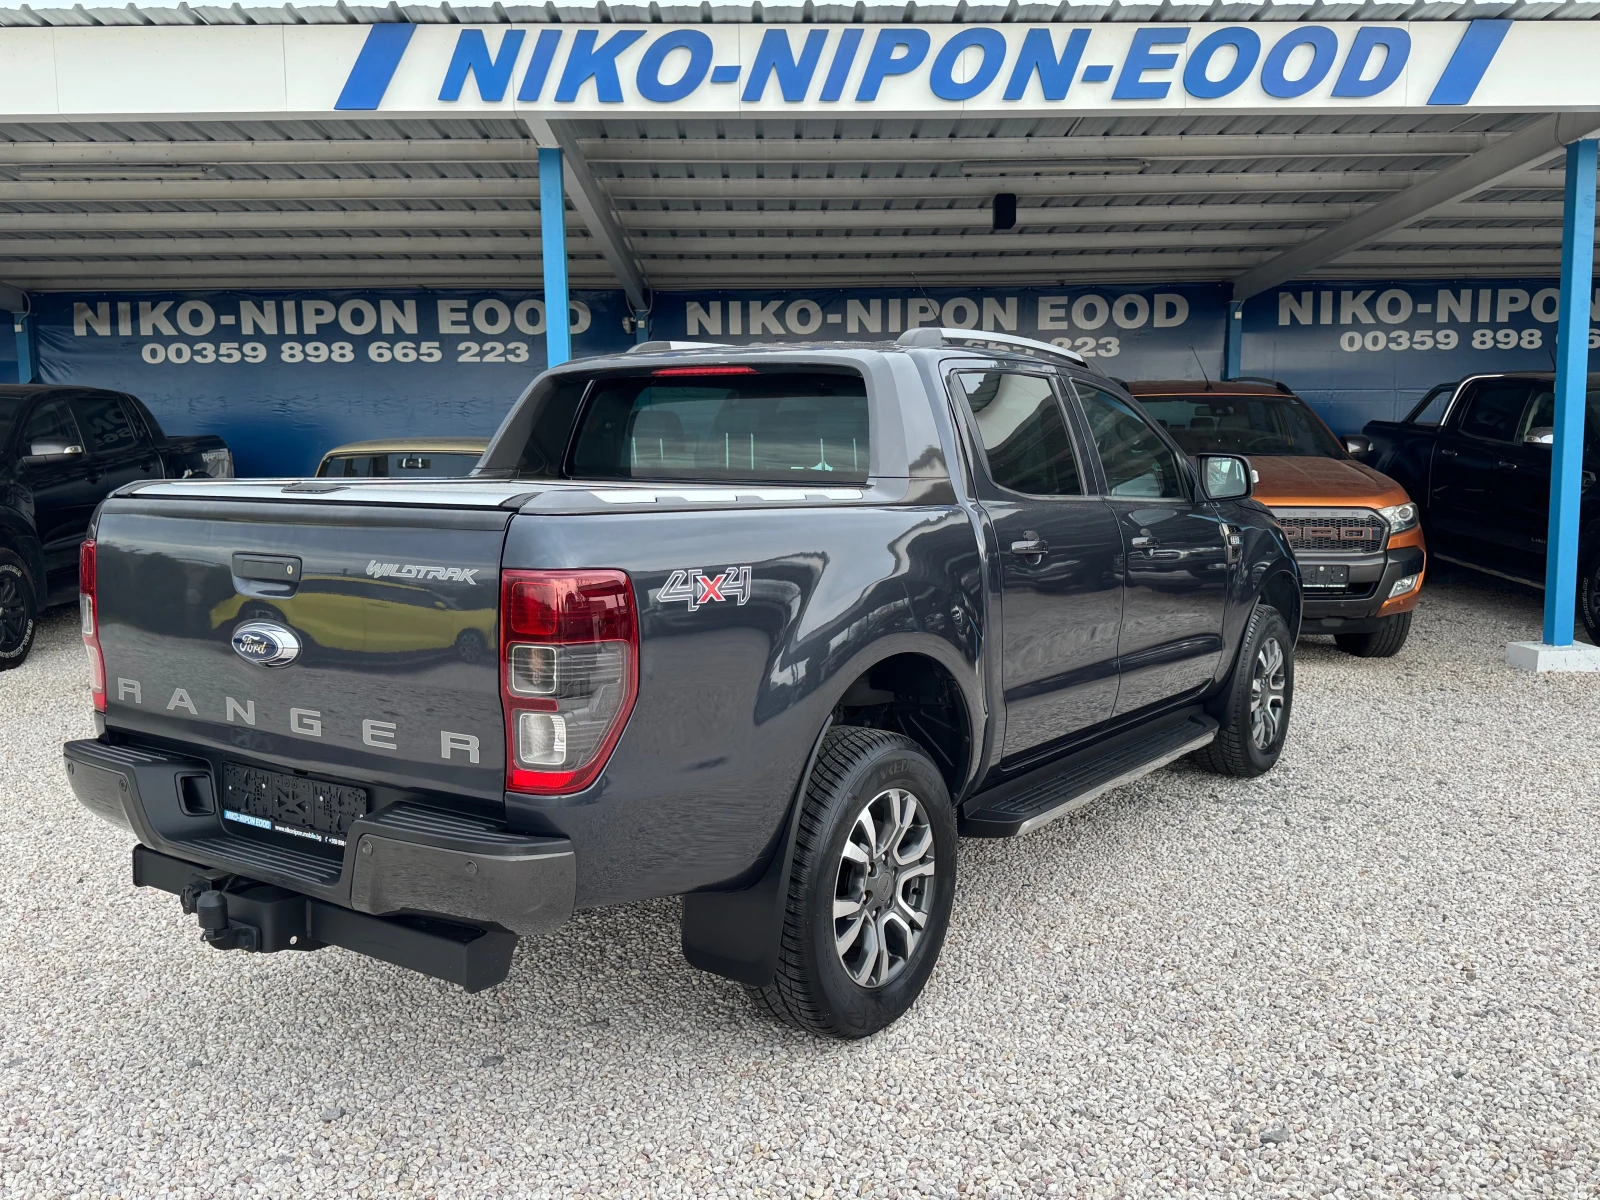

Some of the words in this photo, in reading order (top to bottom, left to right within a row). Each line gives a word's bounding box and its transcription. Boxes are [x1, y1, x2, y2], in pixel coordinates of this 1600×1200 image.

[438, 25, 1412, 103] NIKO-NIPON-EOOD
[72, 299, 419, 337] NIKO-NIPON
[437, 298, 592, 336] EOOD
[685, 296, 1019, 336] NIKO-NIPON
[1037, 293, 1190, 332] EOOD
[140, 342, 267, 365] 00359
[279, 341, 355, 364] 898
[367, 341, 443, 363] 665
[456, 341, 530, 363] 223
[1339, 329, 1460, 352] 00359
[1471, 328, 1543, 350] 898
[364, 559, 480, 586] WILDTRAK
[239, 633, 268, 655] Ford
[117, 676, 481, 765] RANGER
